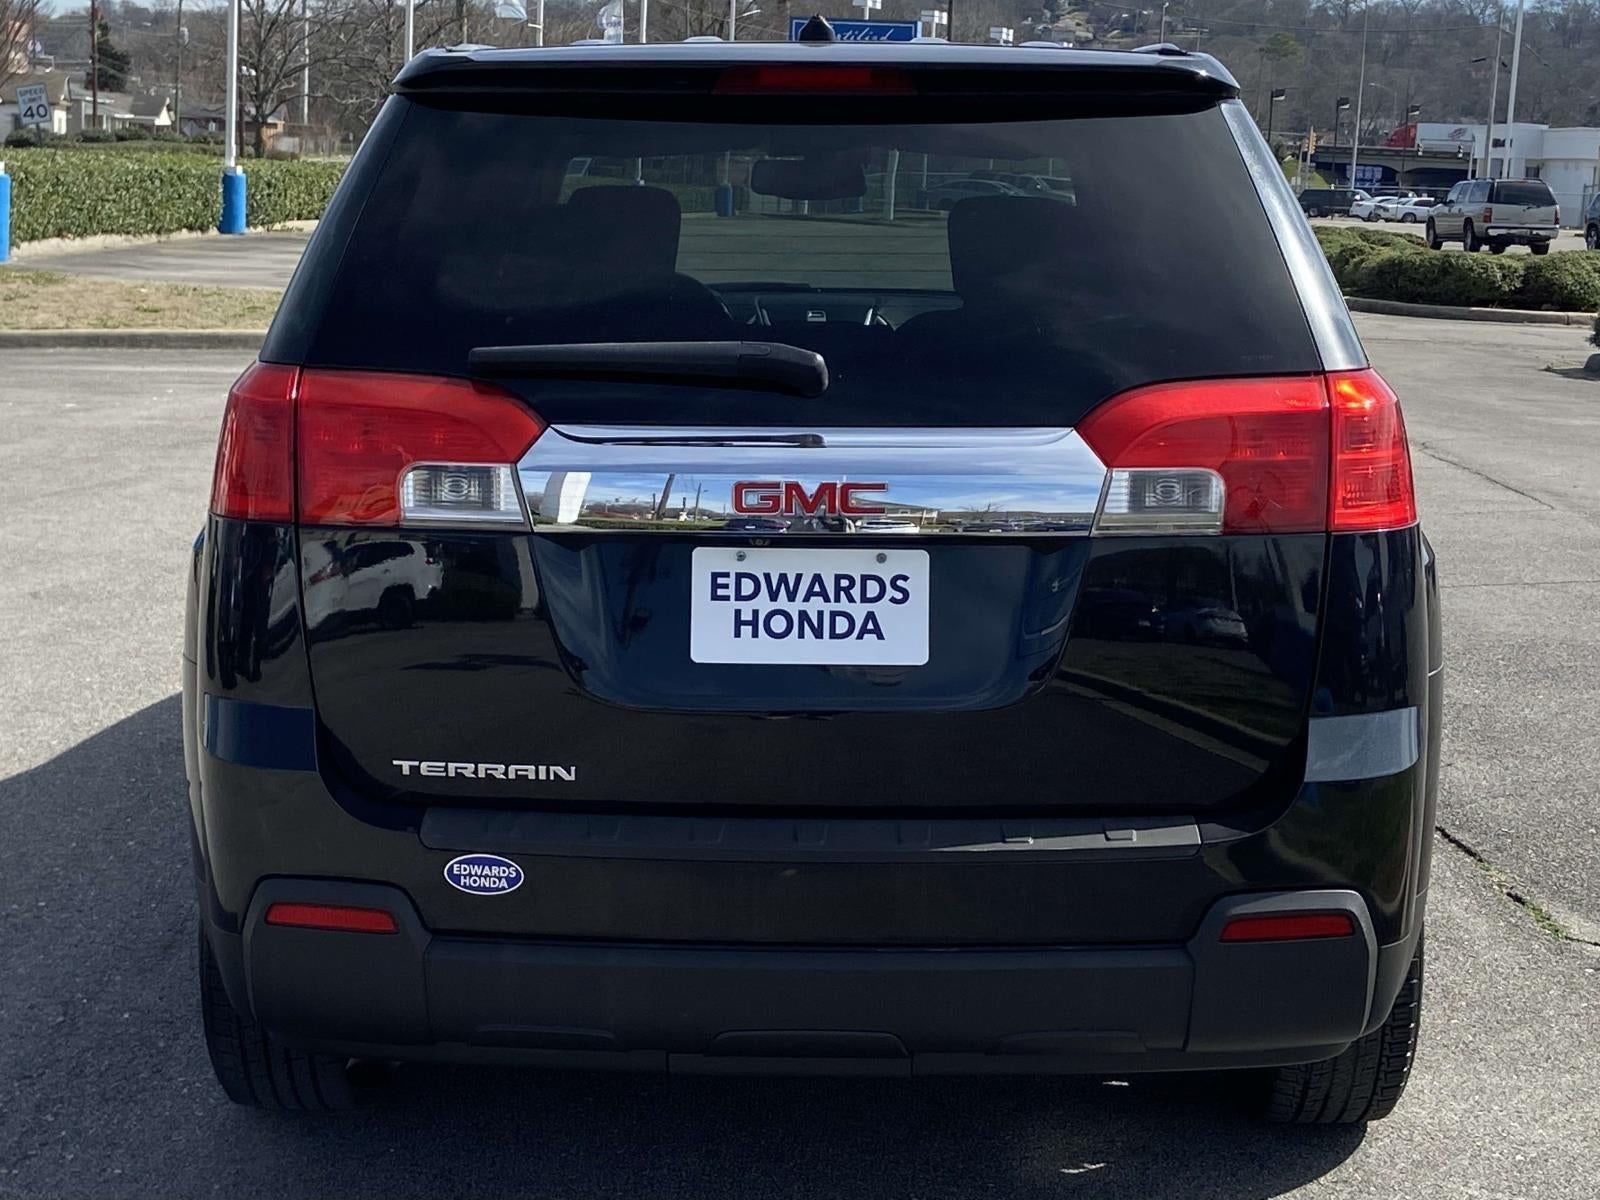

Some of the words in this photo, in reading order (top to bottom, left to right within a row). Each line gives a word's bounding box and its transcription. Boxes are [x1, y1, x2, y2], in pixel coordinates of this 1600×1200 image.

[23, 103, 48, 120] 40
[732, 480, 888, 517] GMC
[710, 571, 911, 605] EDWARDS
[733, 608, 886, 641] HONDA
[392, 759, 576, 781] TERRAIN
[453, 863, 517, 878] EDWARDS
[460, 875, 509, 889] HONDA
